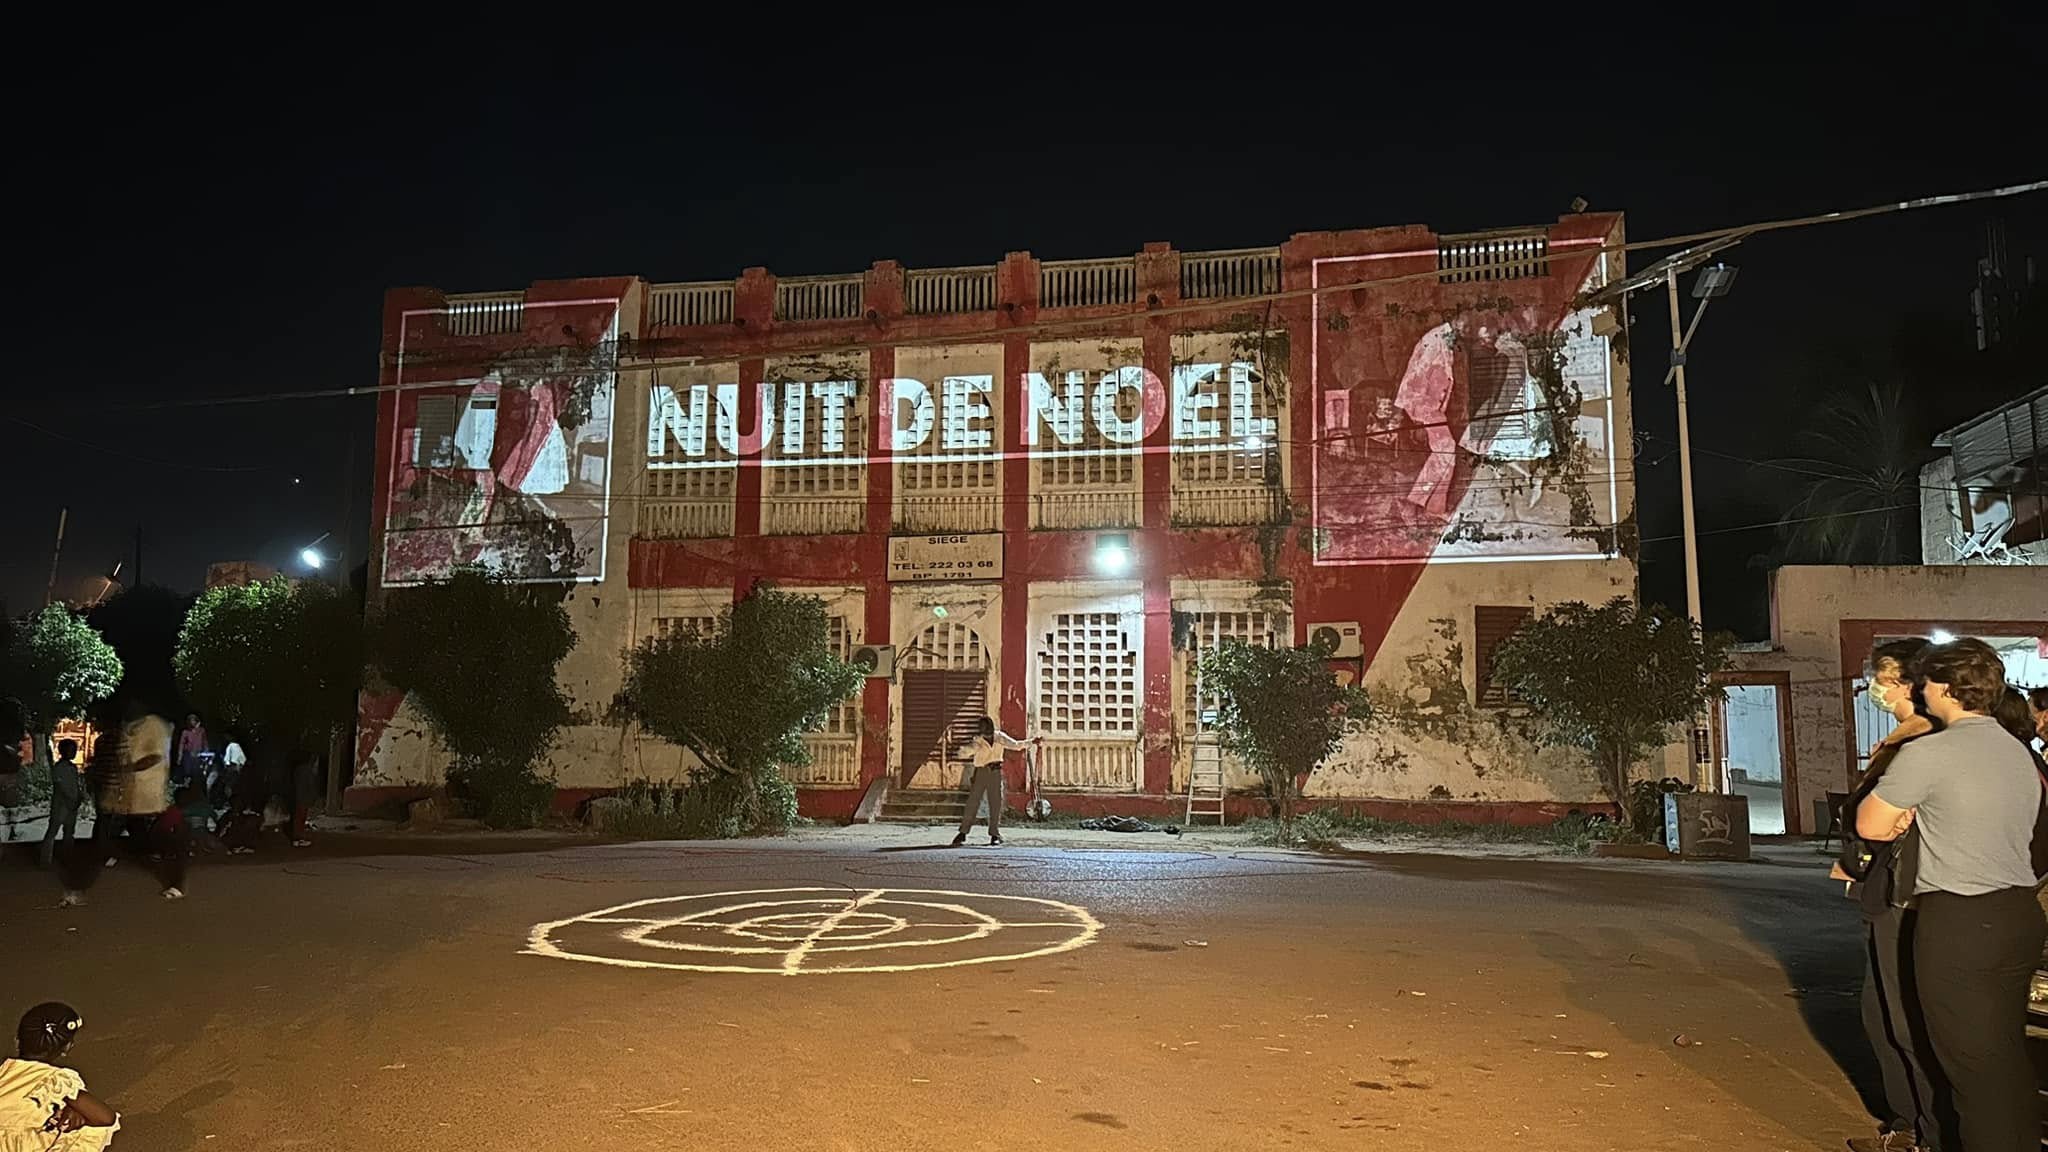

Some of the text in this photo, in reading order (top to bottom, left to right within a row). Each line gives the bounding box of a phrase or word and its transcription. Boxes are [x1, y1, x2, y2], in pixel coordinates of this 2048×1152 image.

[647, 362, 1278, 457] NUIT DE NOEL
[928, 536, 968, 544] SIEGE
[929, 561, 953, 569] 222
[957, 560, 973, 568] 03
[977, 560, 993, 568] 68
